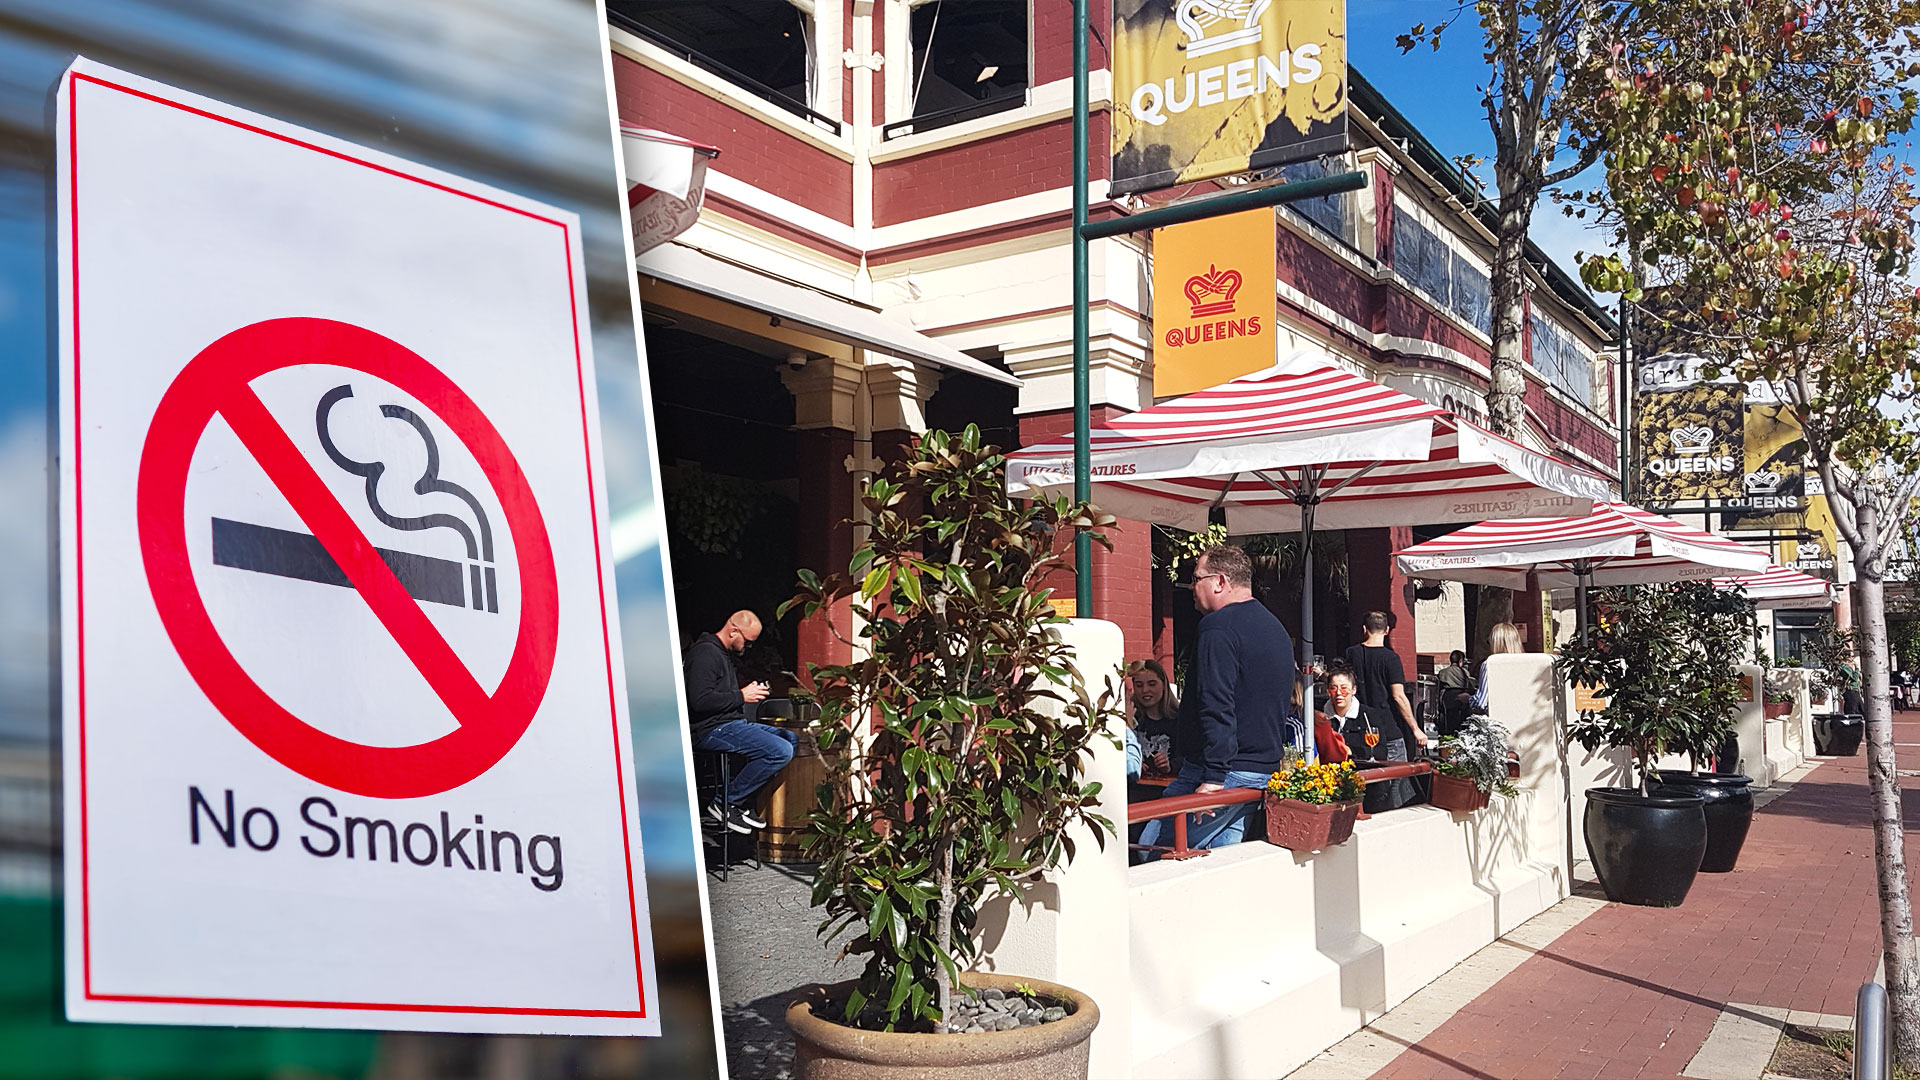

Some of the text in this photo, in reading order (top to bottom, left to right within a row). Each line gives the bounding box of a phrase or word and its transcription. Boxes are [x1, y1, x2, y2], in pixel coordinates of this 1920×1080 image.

[1130, 43, 1322, 126] QUEENS
[1165, 316, 1261, 347] QUEENS
[1649, 455, 1735, 477] QUEENS
[1727, 496, 1798, 509] QUEENS
[1785, 560, 1834, 571] QUEENS
[188, 785, 563, 892] No Smoking
